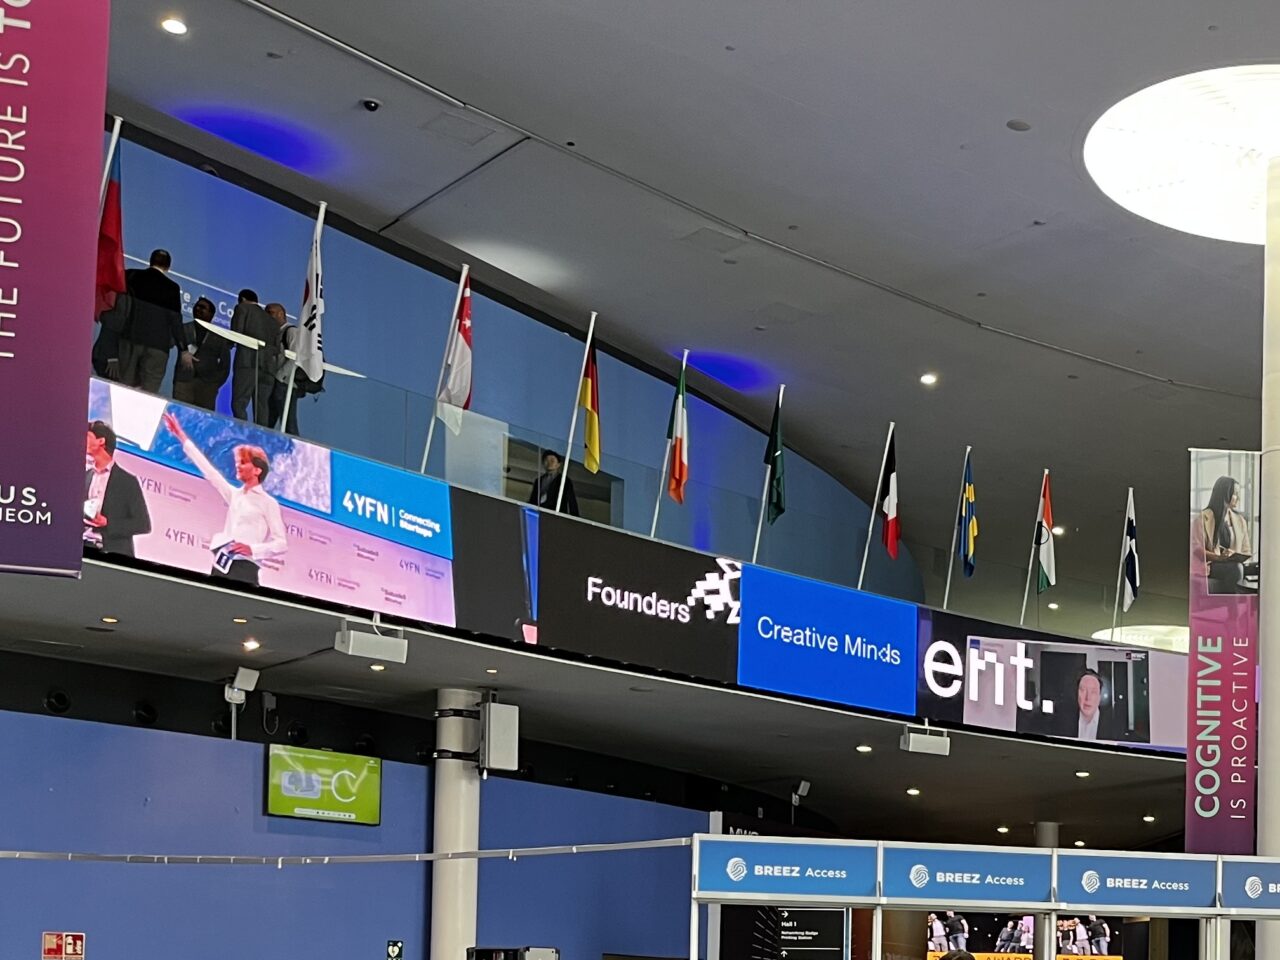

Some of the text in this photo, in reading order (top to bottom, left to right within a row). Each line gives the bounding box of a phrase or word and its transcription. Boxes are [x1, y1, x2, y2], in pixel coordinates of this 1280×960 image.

[139, 476, 163, 495] YFN
[0, 507, 52, 525] EOM
[342, 490, 389, 525] 4YFN
[165, 527, 196, 547] 4YFN
[587, 576, 690, 623] Founders
[757, 615, 901, 666] Creative Minds
[923, 639, 1055, 714] ent.
[1194, 636, 1223, 818] COGNITIVE
[1230, 637, 1249, 819] IS PROACTIVE
[754, 864, 847, 879] BREEZ Access
[936, 872, 1025, 887] BREEZ Access
[1106, 877, 1190, 892] BREEZ Access
